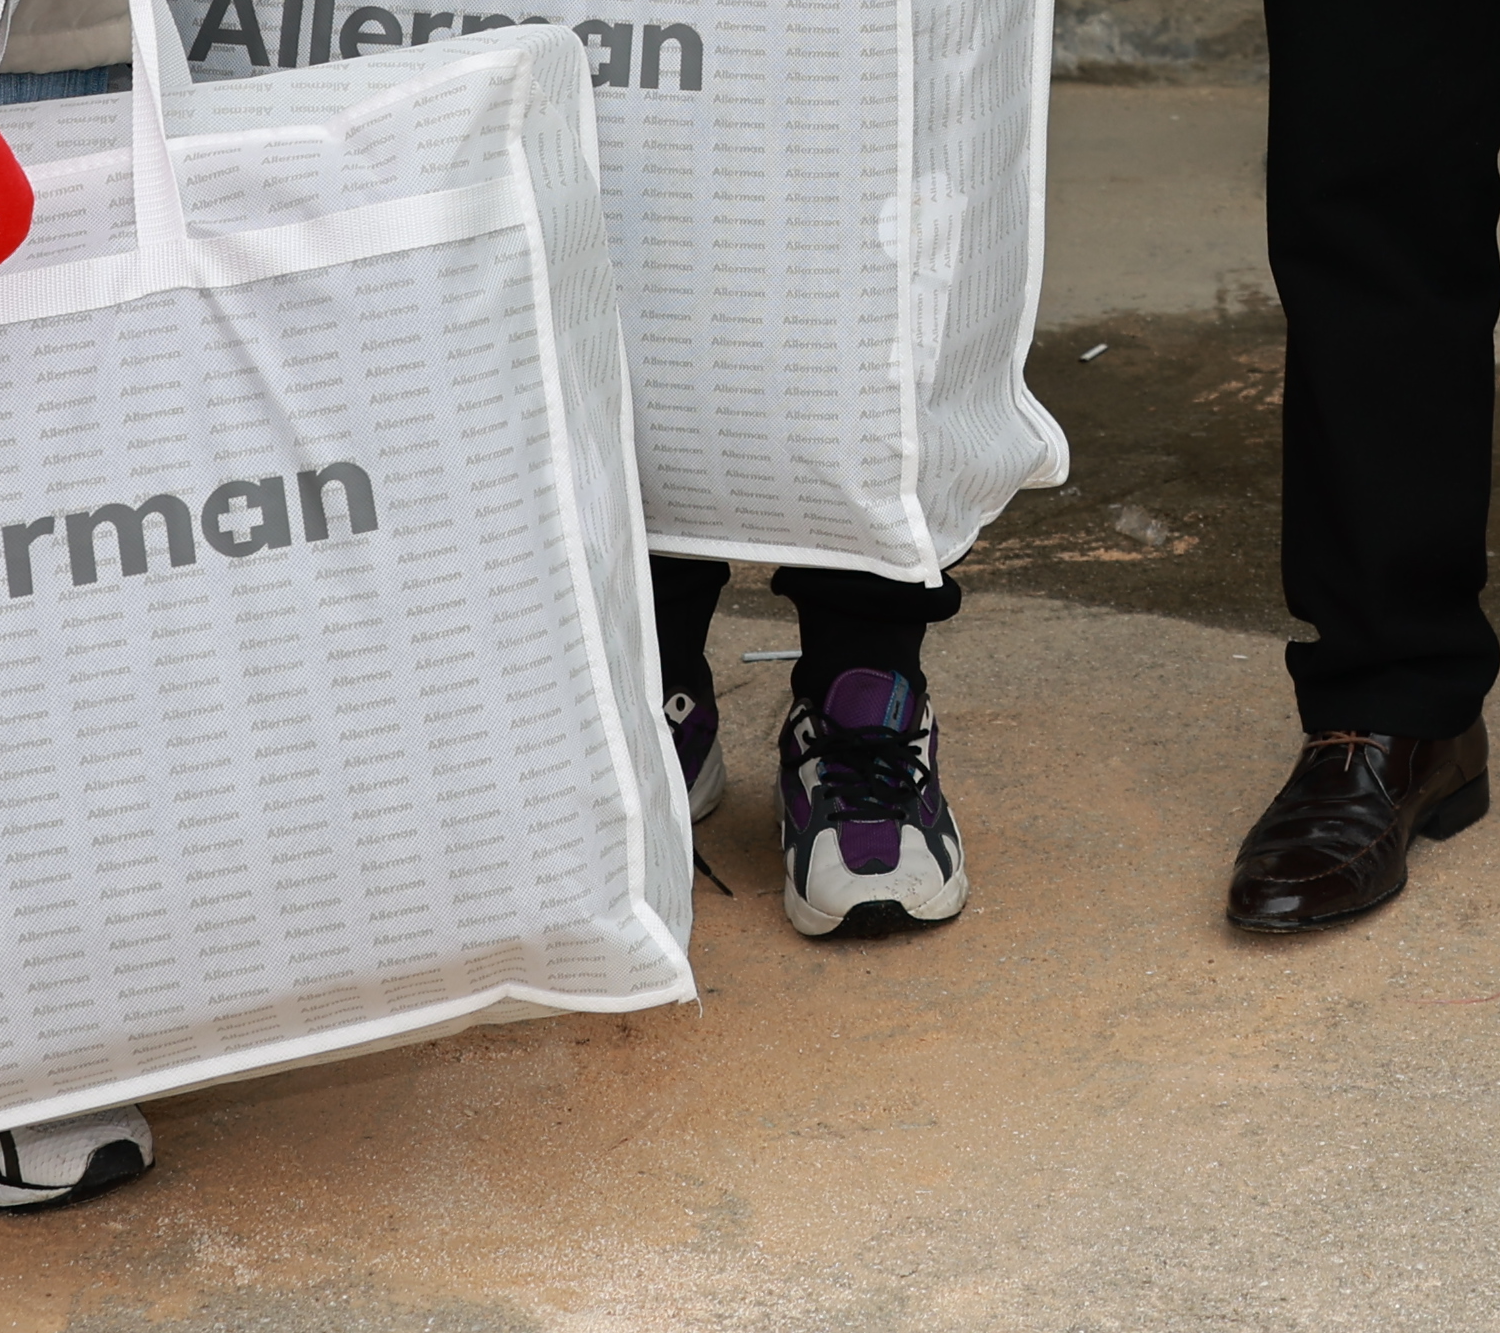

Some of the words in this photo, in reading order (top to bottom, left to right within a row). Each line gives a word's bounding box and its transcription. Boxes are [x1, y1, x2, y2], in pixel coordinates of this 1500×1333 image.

[785, 46, 841, 59] Allerman
[713, 94, 766, 106] Allerman
[642, 115, 695, 128] Allerman
[784, 120, 840, 131] Allerman
[711, 166, 766, 179] Allerman
[784, 192, 841, 205] Allerman
[641, 236, 696, 249] Allerman
[712, 286, 767, 299] Allerman
[441, 315, 492, 336] Allerman
[782, 314, 838, 327] Allerman
[117, 323, 180, 342] Allerman
[281, 350, 340, 368] Allerman
[641, 355, 694, 369] Allerman
[713, 383, 766, 396] Allerman
[783, 386, 839, 398] Allerman
[122, 405, 186, 426] Allerman
[373, 412, 436, 433] Allerman
[212, 443, 274, 462] Allerman
[720, 448, 772, 463] Allerman
[45, 475, 107, 494] Allerman
[469, 471, 521, 493] Allerman
[314, 563, 375, 581] Allerman
[146, 594, 210, 614] Allerman
[409, 623, 472, 645] Allerman
[253, 738, 318, 761] Allerman
[427, 729, 490, 751] Allerman
[527, 811, 579, 835] Allerman
[90, 827, 156, 848] Allerman
[355, 827, 419, 848] Allerman
[184, 863, 250, 884] Allerman
[456, 909, 518, 929] Allerman
[16, 924, 83, 945] Allerman
[283, 920, 347, 941] Allerman
[117, 980, 181, 1001] Allerman
